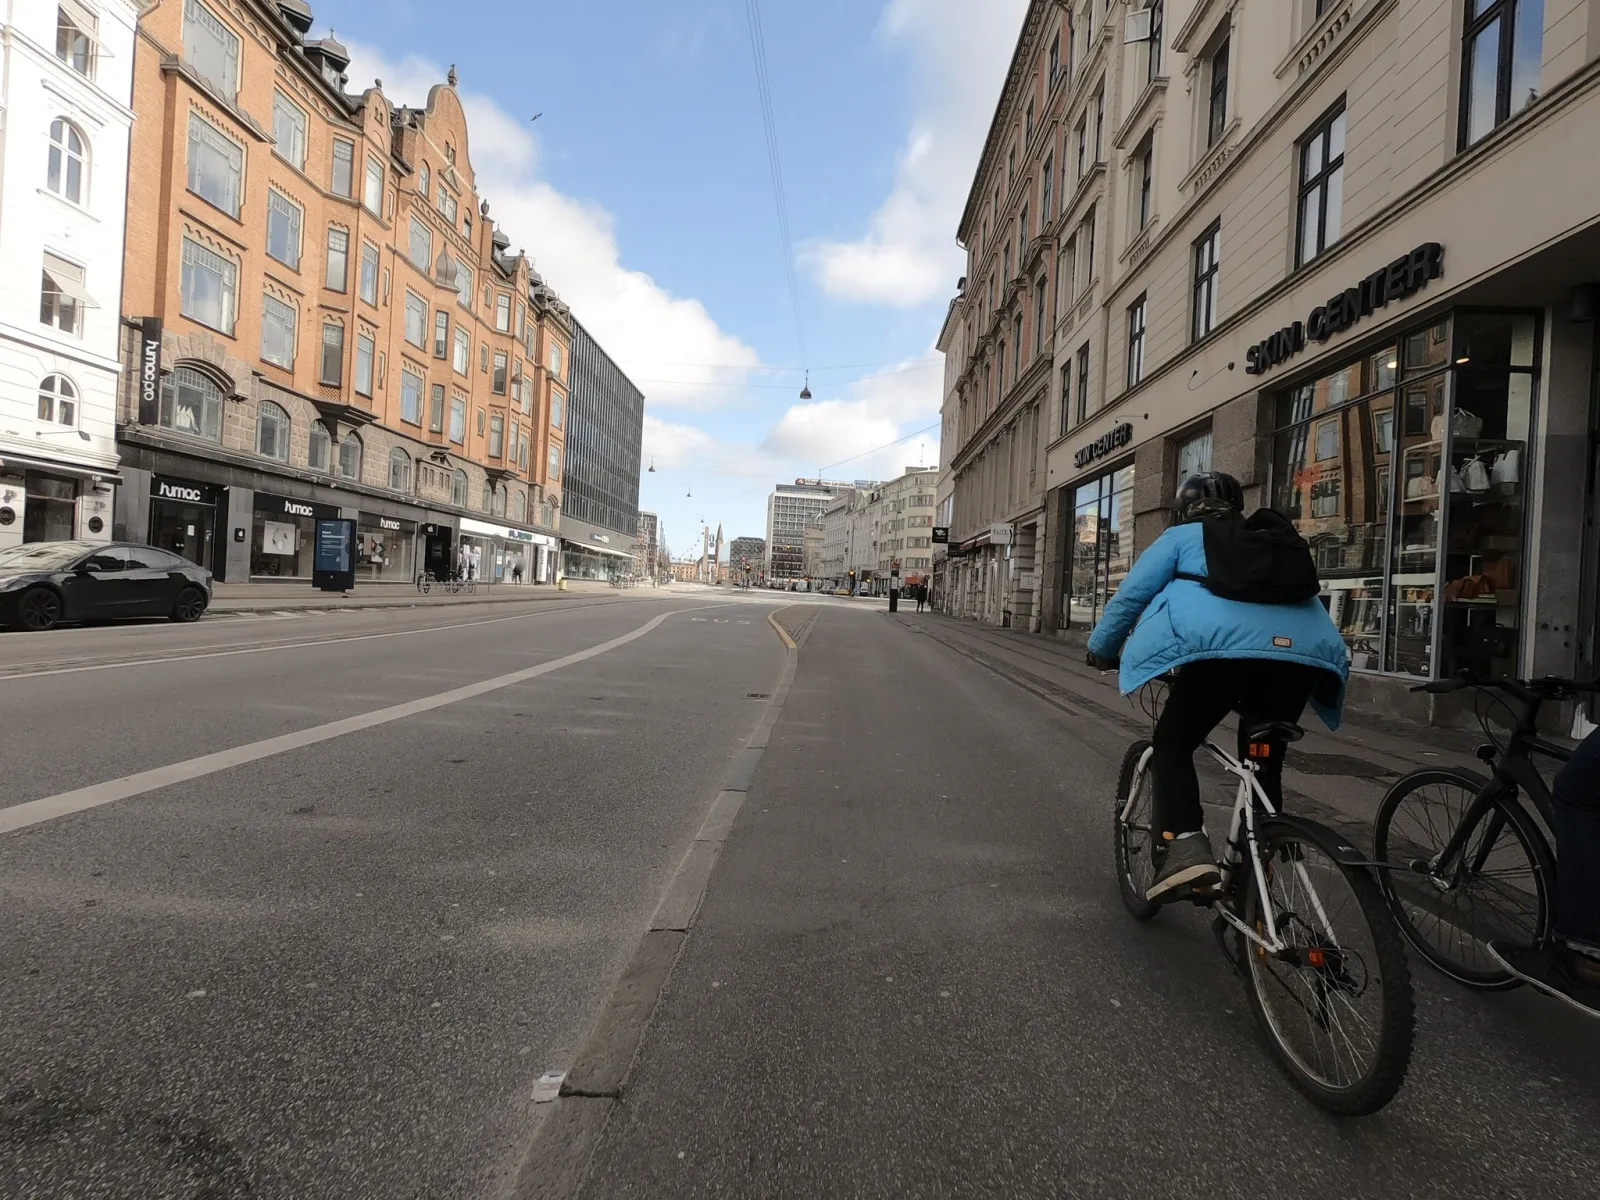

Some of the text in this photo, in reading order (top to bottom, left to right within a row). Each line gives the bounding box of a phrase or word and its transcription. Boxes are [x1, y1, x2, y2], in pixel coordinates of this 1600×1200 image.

[1245, 242, 1445, 375] SKIN CENTER
[1074, 422, 1133, 469] SKIN CENTER
[159, 482, 201, 501] humac
[284, 500, 313, 516] humac
[380, 517, 400, 530] humac
